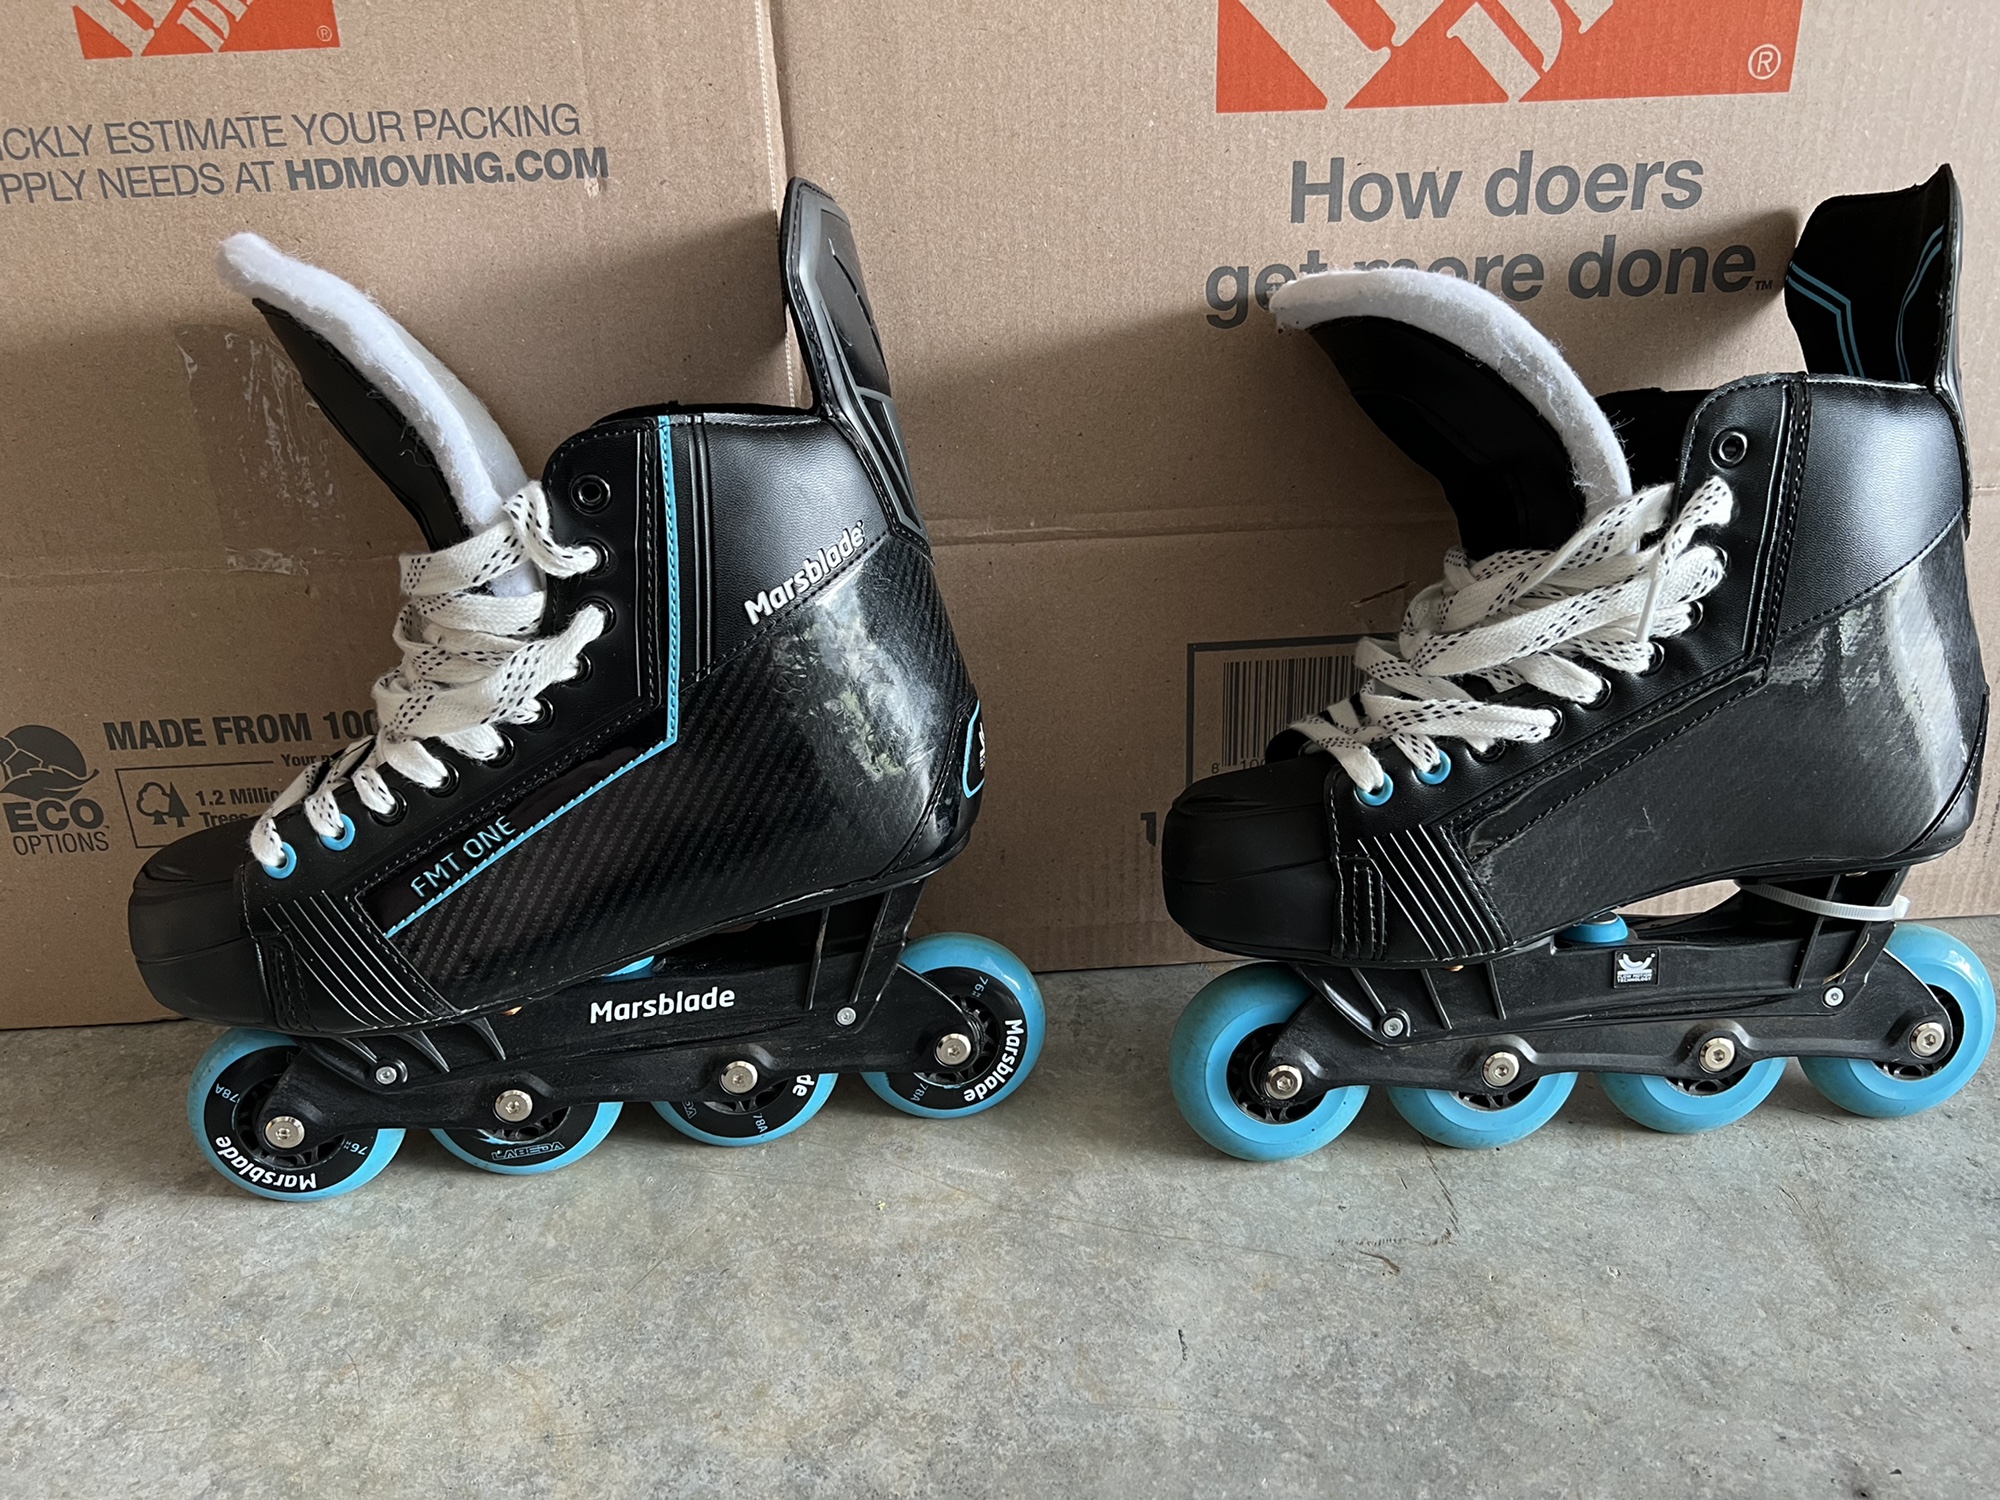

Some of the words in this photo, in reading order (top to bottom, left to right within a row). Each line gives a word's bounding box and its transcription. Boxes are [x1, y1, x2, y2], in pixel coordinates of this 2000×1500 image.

[104, 115, 284, 154] ESTIMATE
[291, 110, 405, 146] YOUR
[413, 103, 580, 141] PACKING
[97, 162, 224, 199] NEEDS
[235, 160, 275, 193] AT
[285, 146, 609, 191] HDMOVING.COM
[1290, 156, 1463, 223] How
[1483, 150, 1704, 216] doers
[744, 525, 865, 625] Marsblade
[103, 718, 206, 750] MADE
[212, 712, 313, 745] FROM
[4, 799, 105, 833] ECO
[195, 790, 226, 806] 1.2
[13, 831, 110, 856] OPTIONS
[410, 852, 463, 898] FMT
[463, 815, 517, 858] ONE
[589, 985, 736, 1024] Marsblade
[963, 1018, 1025, 1102] Marsblade
[214, 1083, 241, 1103] 78A
[752, 1112, 769, 1133] 78A
[215, 1135, 317, 1191] Marsblade
